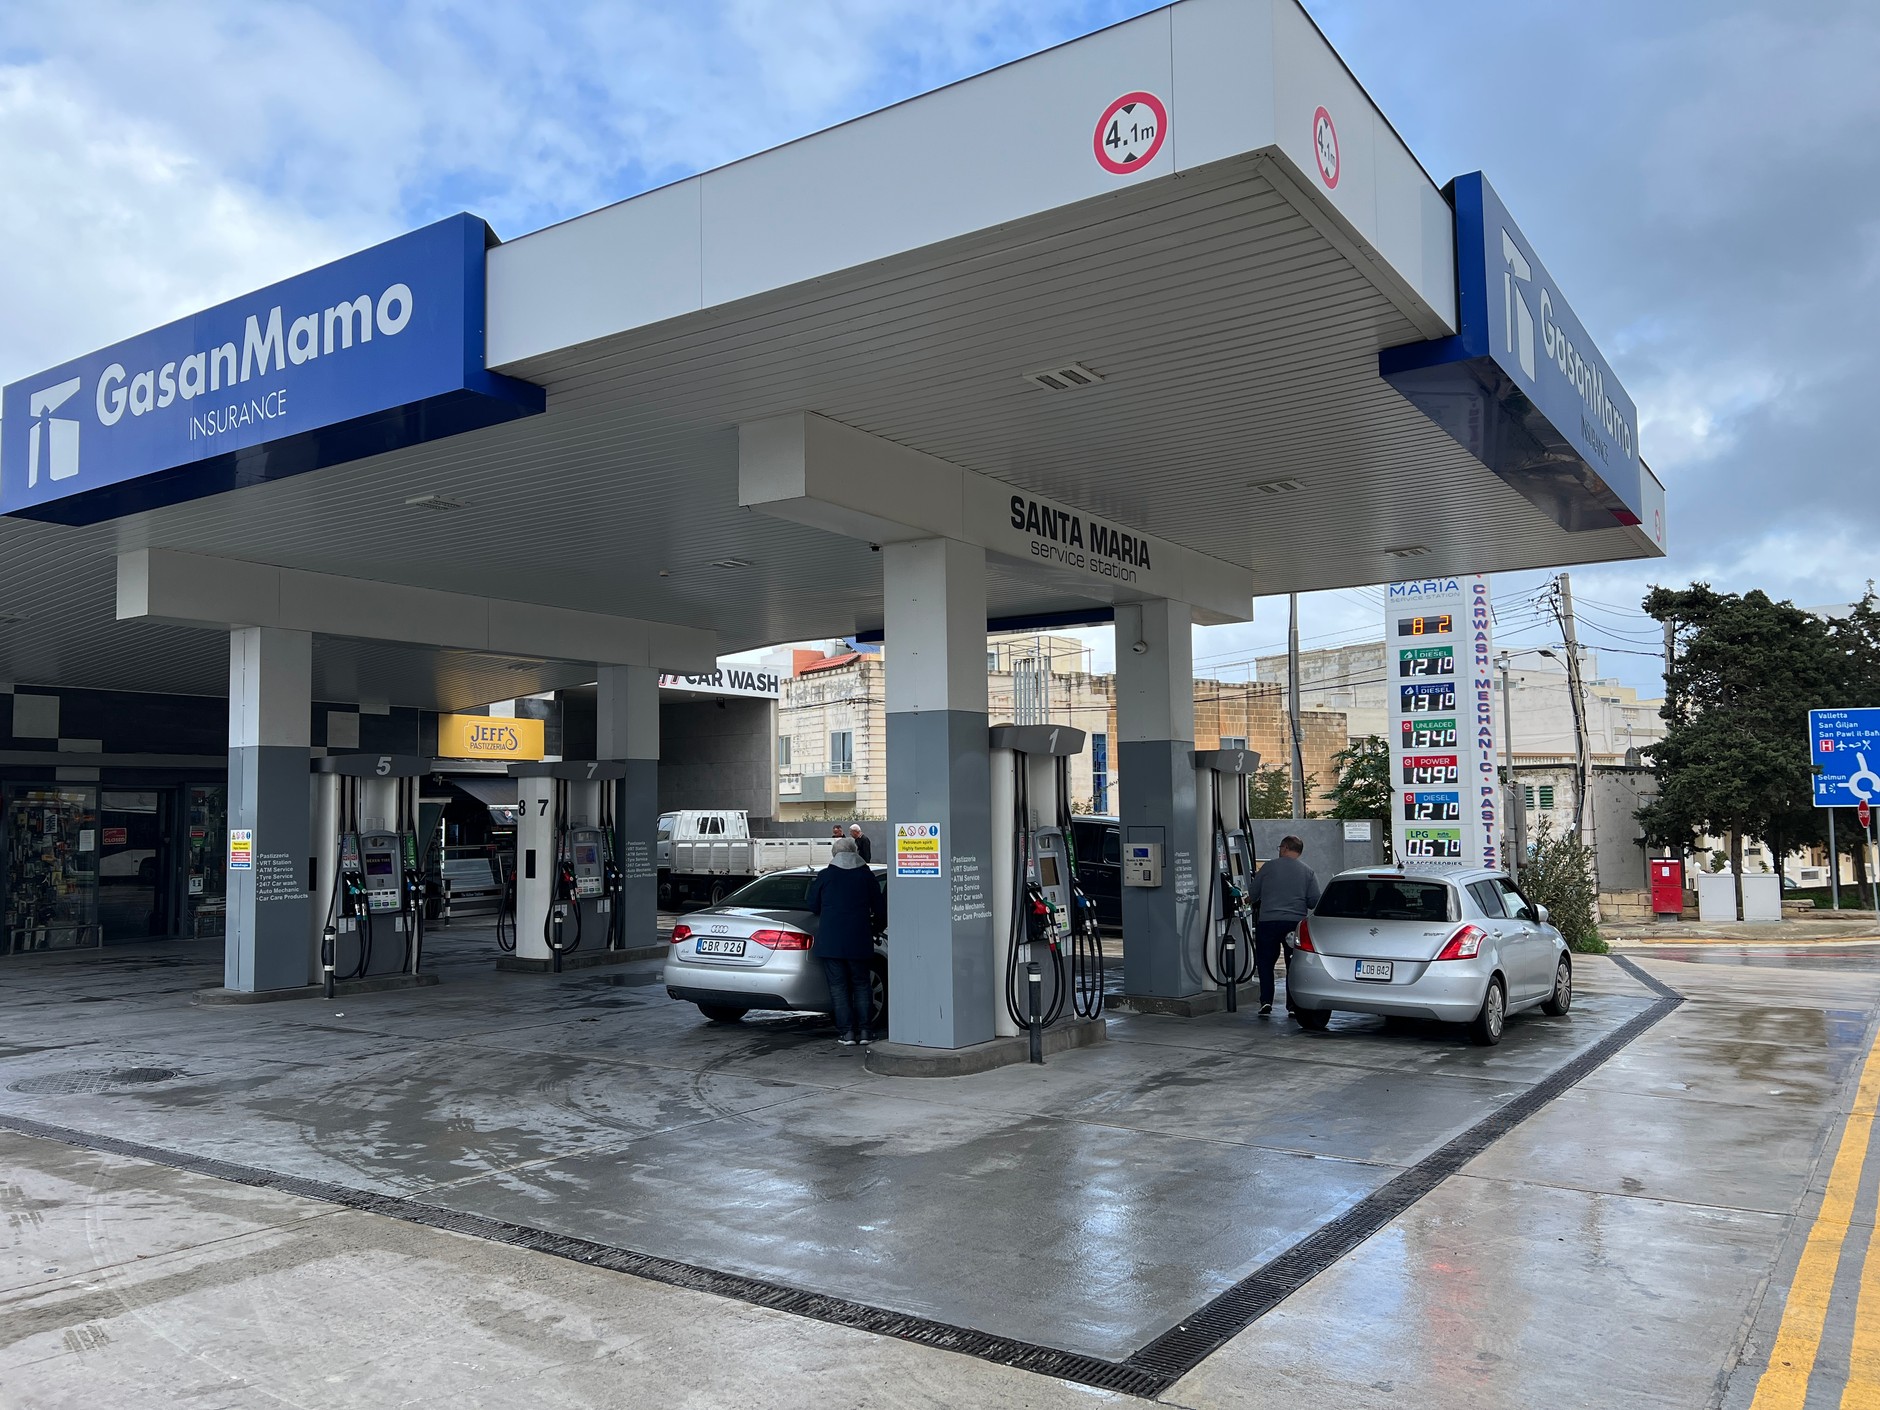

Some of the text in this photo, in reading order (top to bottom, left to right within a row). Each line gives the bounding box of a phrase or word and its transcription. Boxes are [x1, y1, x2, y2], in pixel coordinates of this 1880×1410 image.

[1106, 120, 1154, 148] 4.1m
[1318, 125, 1335, 168] 4.1m
[96, 283, 413, 426] GasanMamo
[1540, 287, 1632, 460] GasanMamo
[188, 389, 287, 441] INSURANCE
[1581, 414, 1608, 467] INSURANCE
[1010, 496, 1150, 570] SANTA MARIA
[1031, 540, 1136, 583] service station
[1390, 581, 1459, 597] MARIA
[1472, 584, 1488, 665] CARWASH
[727, 670, 778, 693] WASH
[1474, 679, 1492, 772] MECHANIC
[470, 742, 506, 750] PASTIZZERIA
[471, 725, 518, 750] JEFF'S
[1049, 729, 1059, 753] 1
[376, 757, 392, 775] 5
[586, 763, 598, 779] 7
[1234, 752, 1244, 771] 3
[518, 800, 526, 816] 8
[538, 799, 549, 816] 7
[954, 885, 963, 893] Tyre
[964, 874, 980, 882] Service
[965, 902, 985, 910] Mechanic
[973, 911, 992, 919] Products
[702, 941, 741, 953] CBR 926
